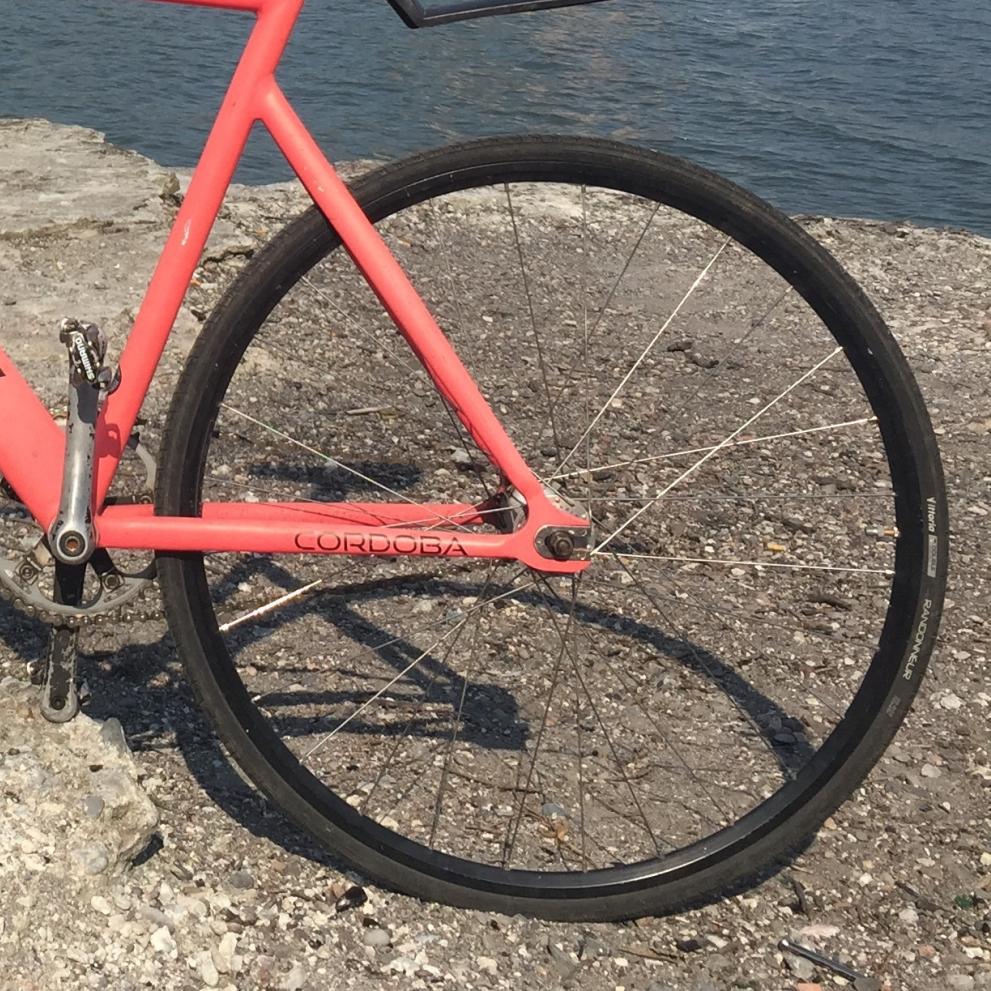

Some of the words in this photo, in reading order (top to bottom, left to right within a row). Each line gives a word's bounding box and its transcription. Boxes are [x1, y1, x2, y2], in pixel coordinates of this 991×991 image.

[75, 336, 96, 380] SHIMANO
[294, 532, 469, 556] CORDOBA
[903, 599, 932, 680] RANDONNEUR
